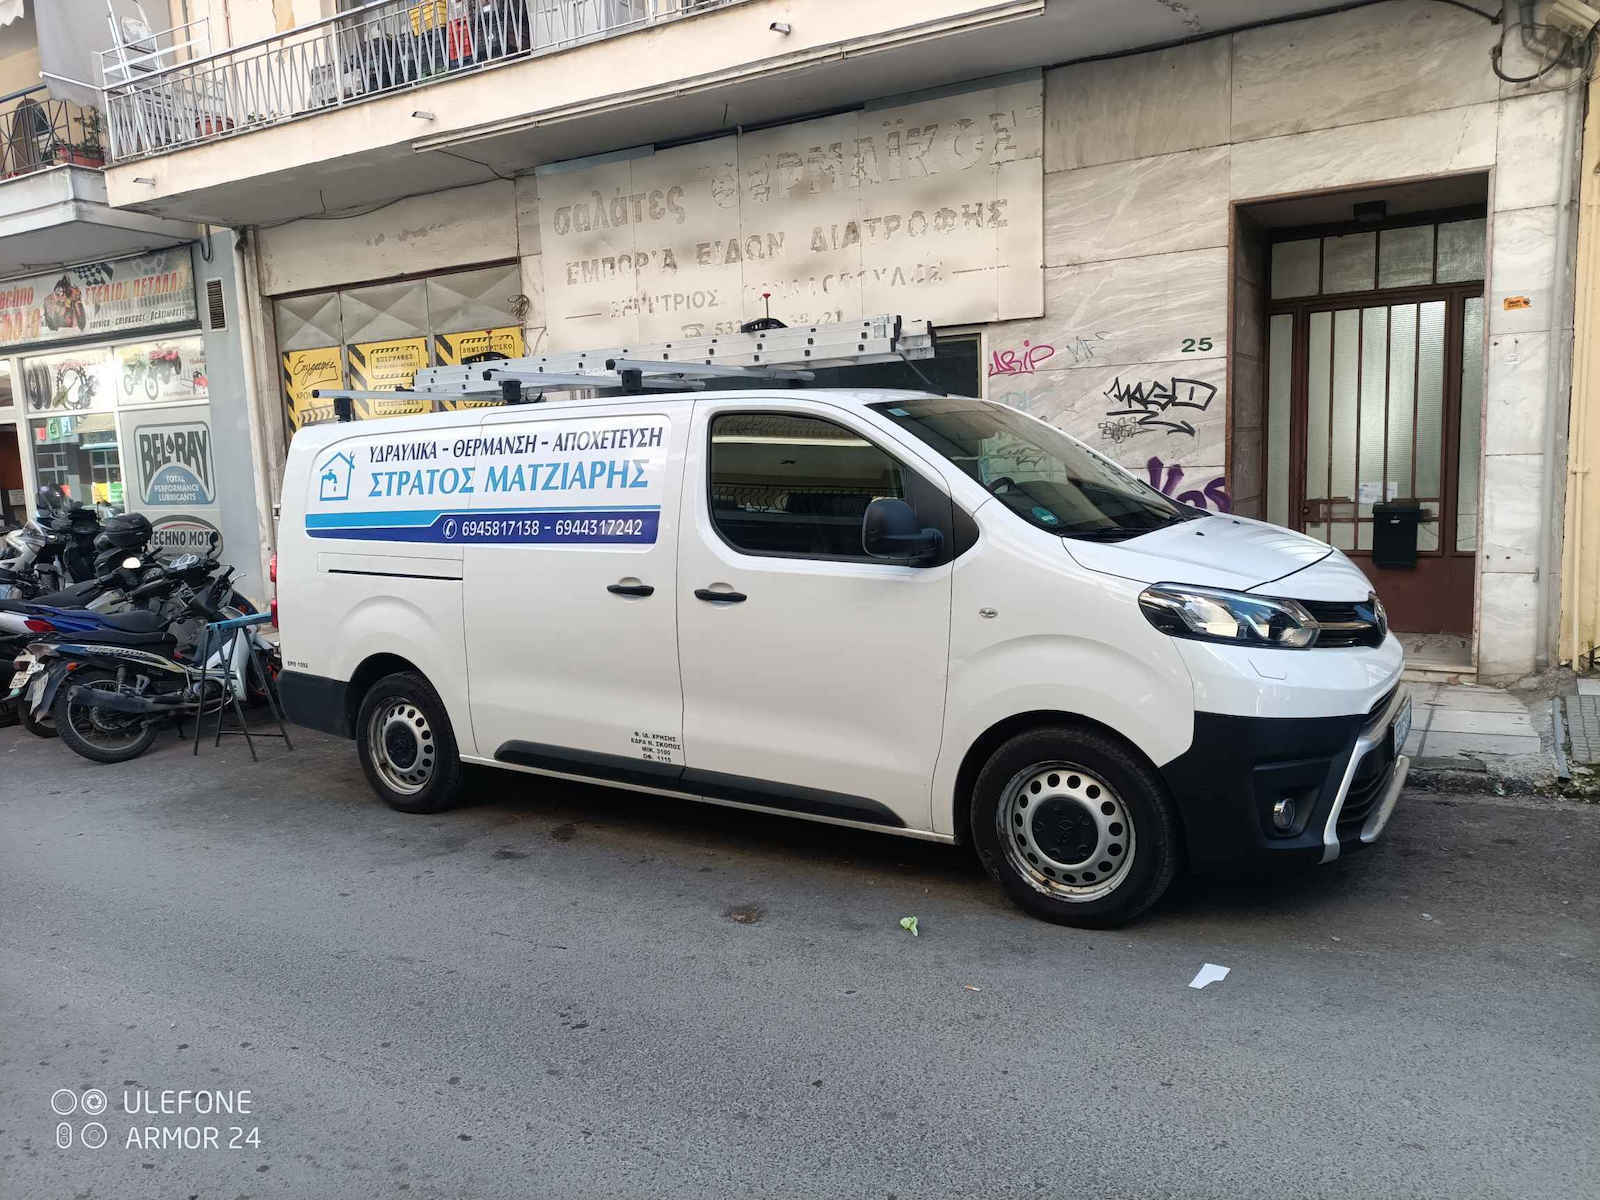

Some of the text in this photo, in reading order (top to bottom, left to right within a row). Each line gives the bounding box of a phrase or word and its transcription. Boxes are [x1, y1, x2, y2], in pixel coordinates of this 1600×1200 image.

[566, 248, 680, 286] ΕΜΠΟΡΑ
[1181, 337, 1213, 352] 25
[368, 440, 438, 464] ΥΔΡΑΥΛΙΚΑ
[453, 434, 538, 458] ΘΕΡΜΑΝΣΗ
[552, 427, 664, 452] ΑΠΟΧΕΤΕΥΣΗ
[368, 459, 650, 497] ΣΤΡΑΤΟΣ ΜΑΤΖΙΑΡΗΣ
[150, 530, 217, 546] ECHNO MOT
[462, 520, 540, 536] 6945817138
[555, 519, 643, 536] 6944317242
